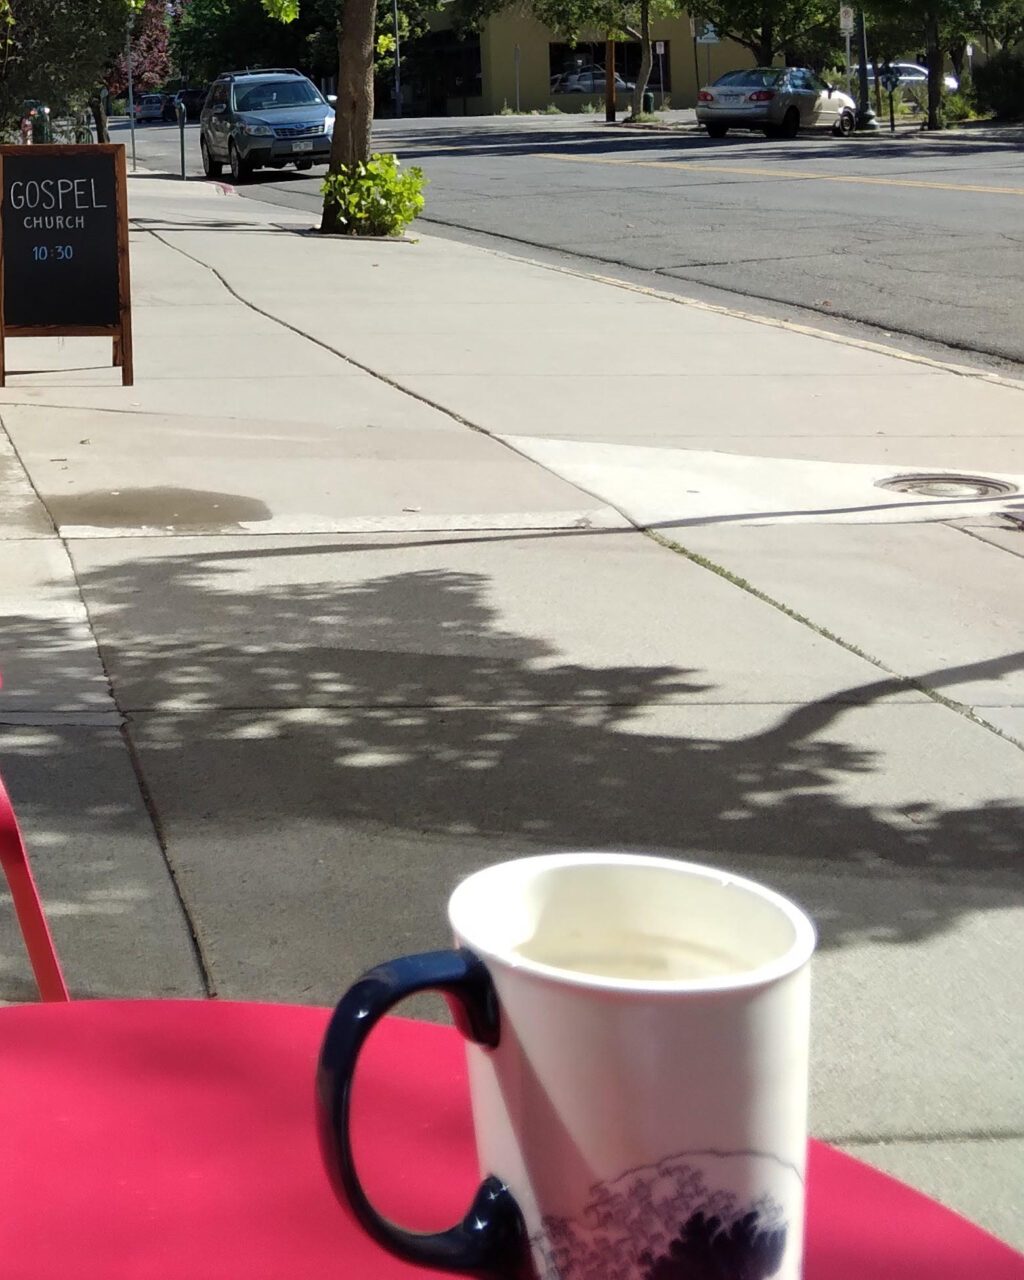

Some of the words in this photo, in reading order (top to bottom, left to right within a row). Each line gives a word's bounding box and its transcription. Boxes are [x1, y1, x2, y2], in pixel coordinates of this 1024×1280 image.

[10, 178, 108, 210] GOSPEL
[23, 215, 85, 229] CHURCH
[32, 245, 73, 261] 10:30
